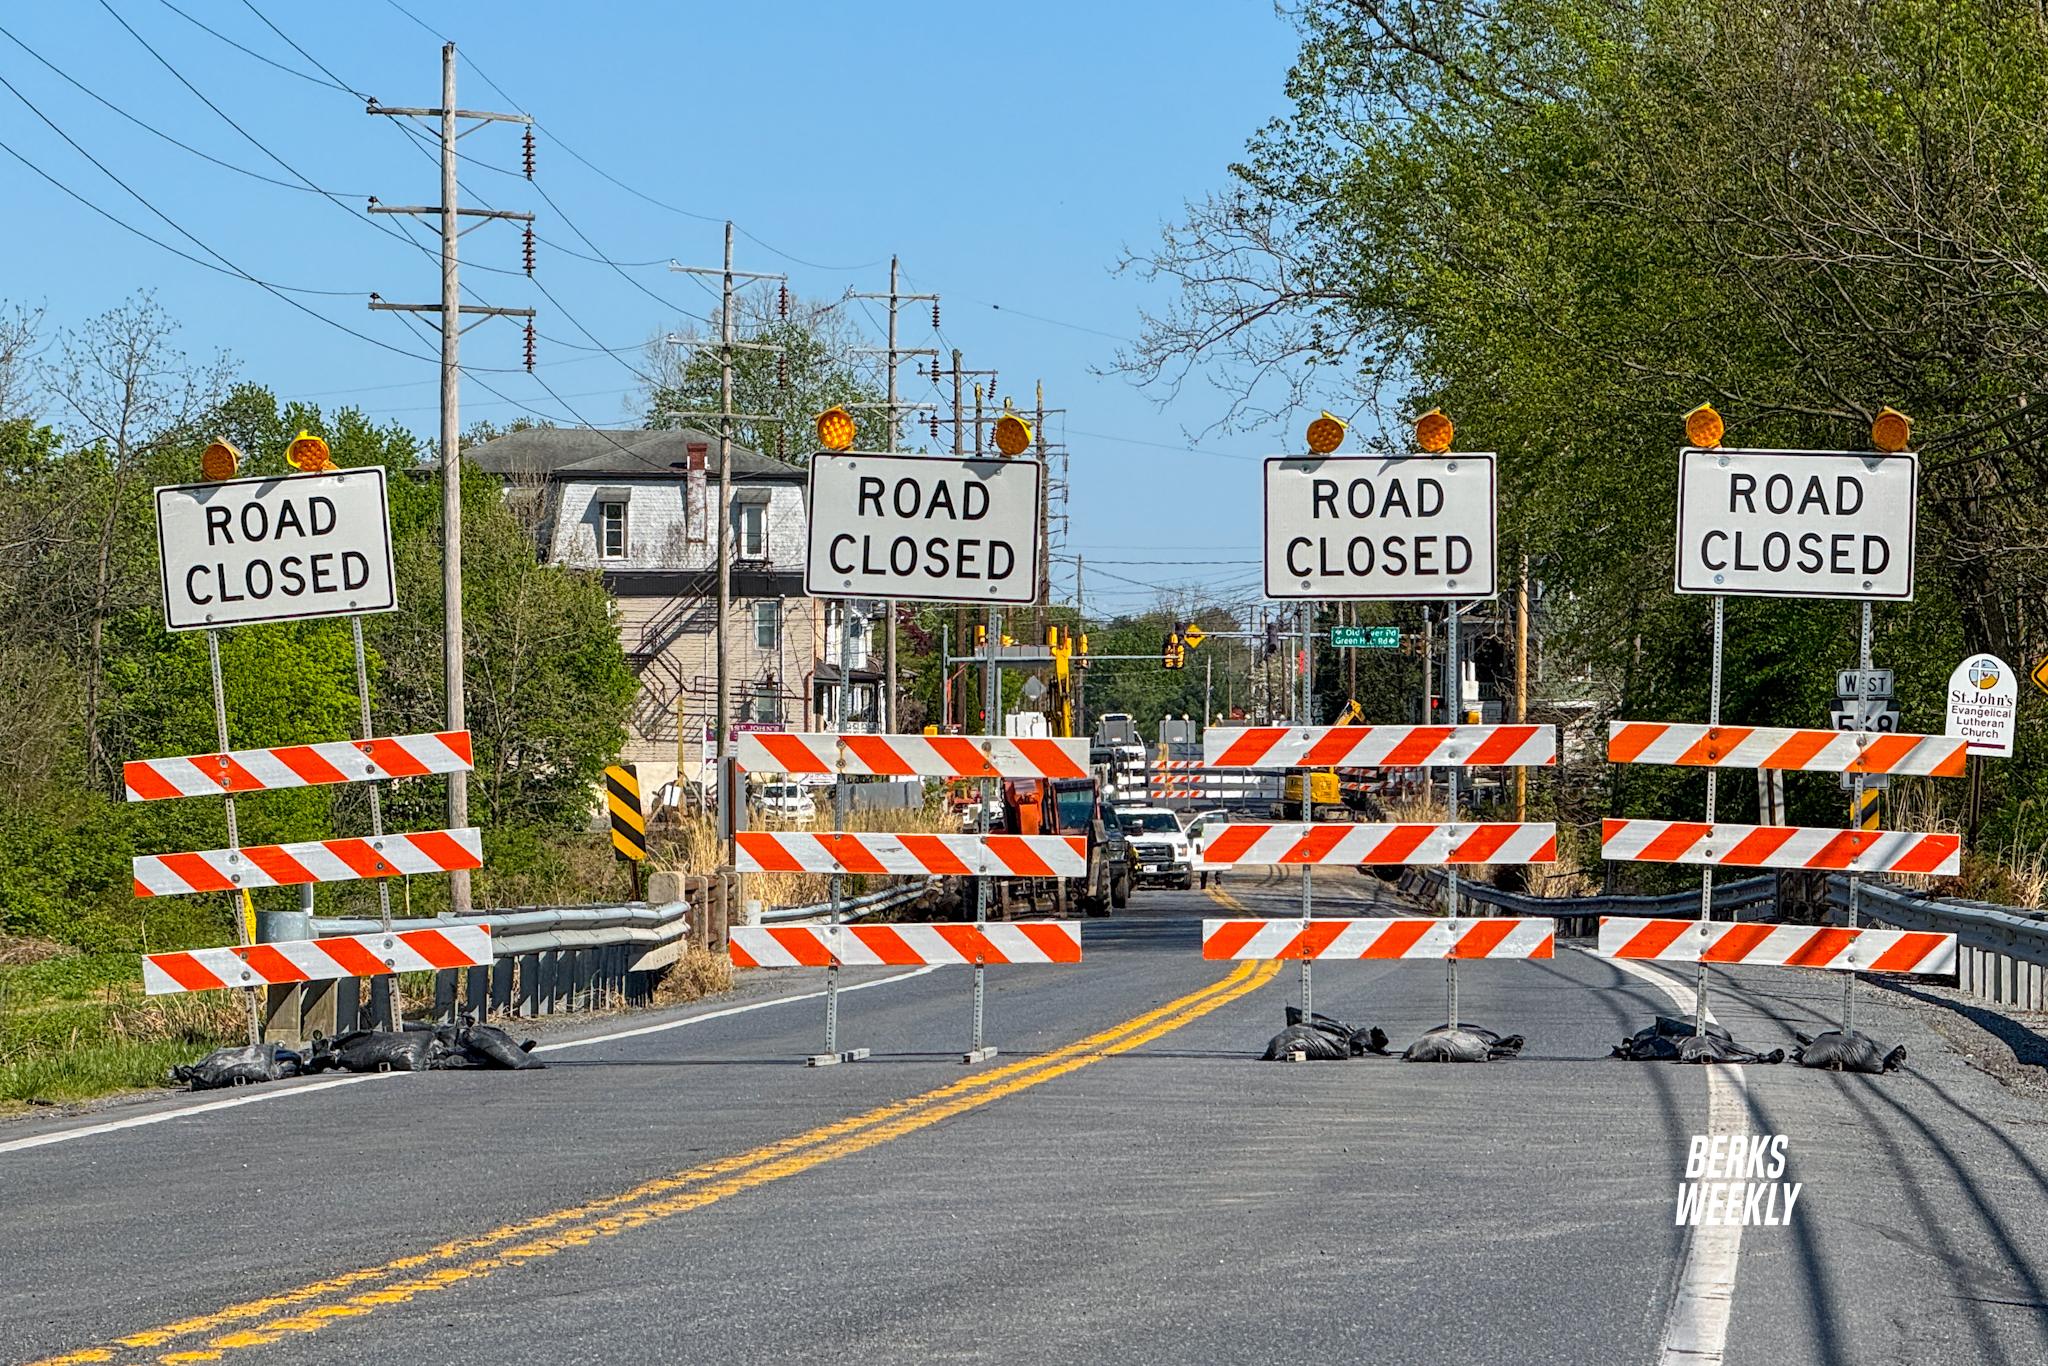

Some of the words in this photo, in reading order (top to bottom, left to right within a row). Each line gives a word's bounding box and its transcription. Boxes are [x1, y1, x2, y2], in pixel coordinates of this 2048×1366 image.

[859, 477, 989, 520] ROAD
[1313, 478, 1443, 518] ROAD
[1730, 474, 1863, 515] ROAD
[206, 497, 336, 545] ROAD
[830, 534, 1014, 580] CLOSED
[1287, 535, 1472, 577] CLOSED
[1702, 531, 1889, 574] CLOSED
[187, 552, 369, 605] CLOSED
[1335, 637, 1358, 645] Green
[1378, 637, 1388, 645] Rd
[1844, 675, 1886, 693] WST
[1951, 705, 2011, 719] Evangelical
[1956, 716, 2004, 728] Lutheran
[1961, 726, 1999, 738] Church
